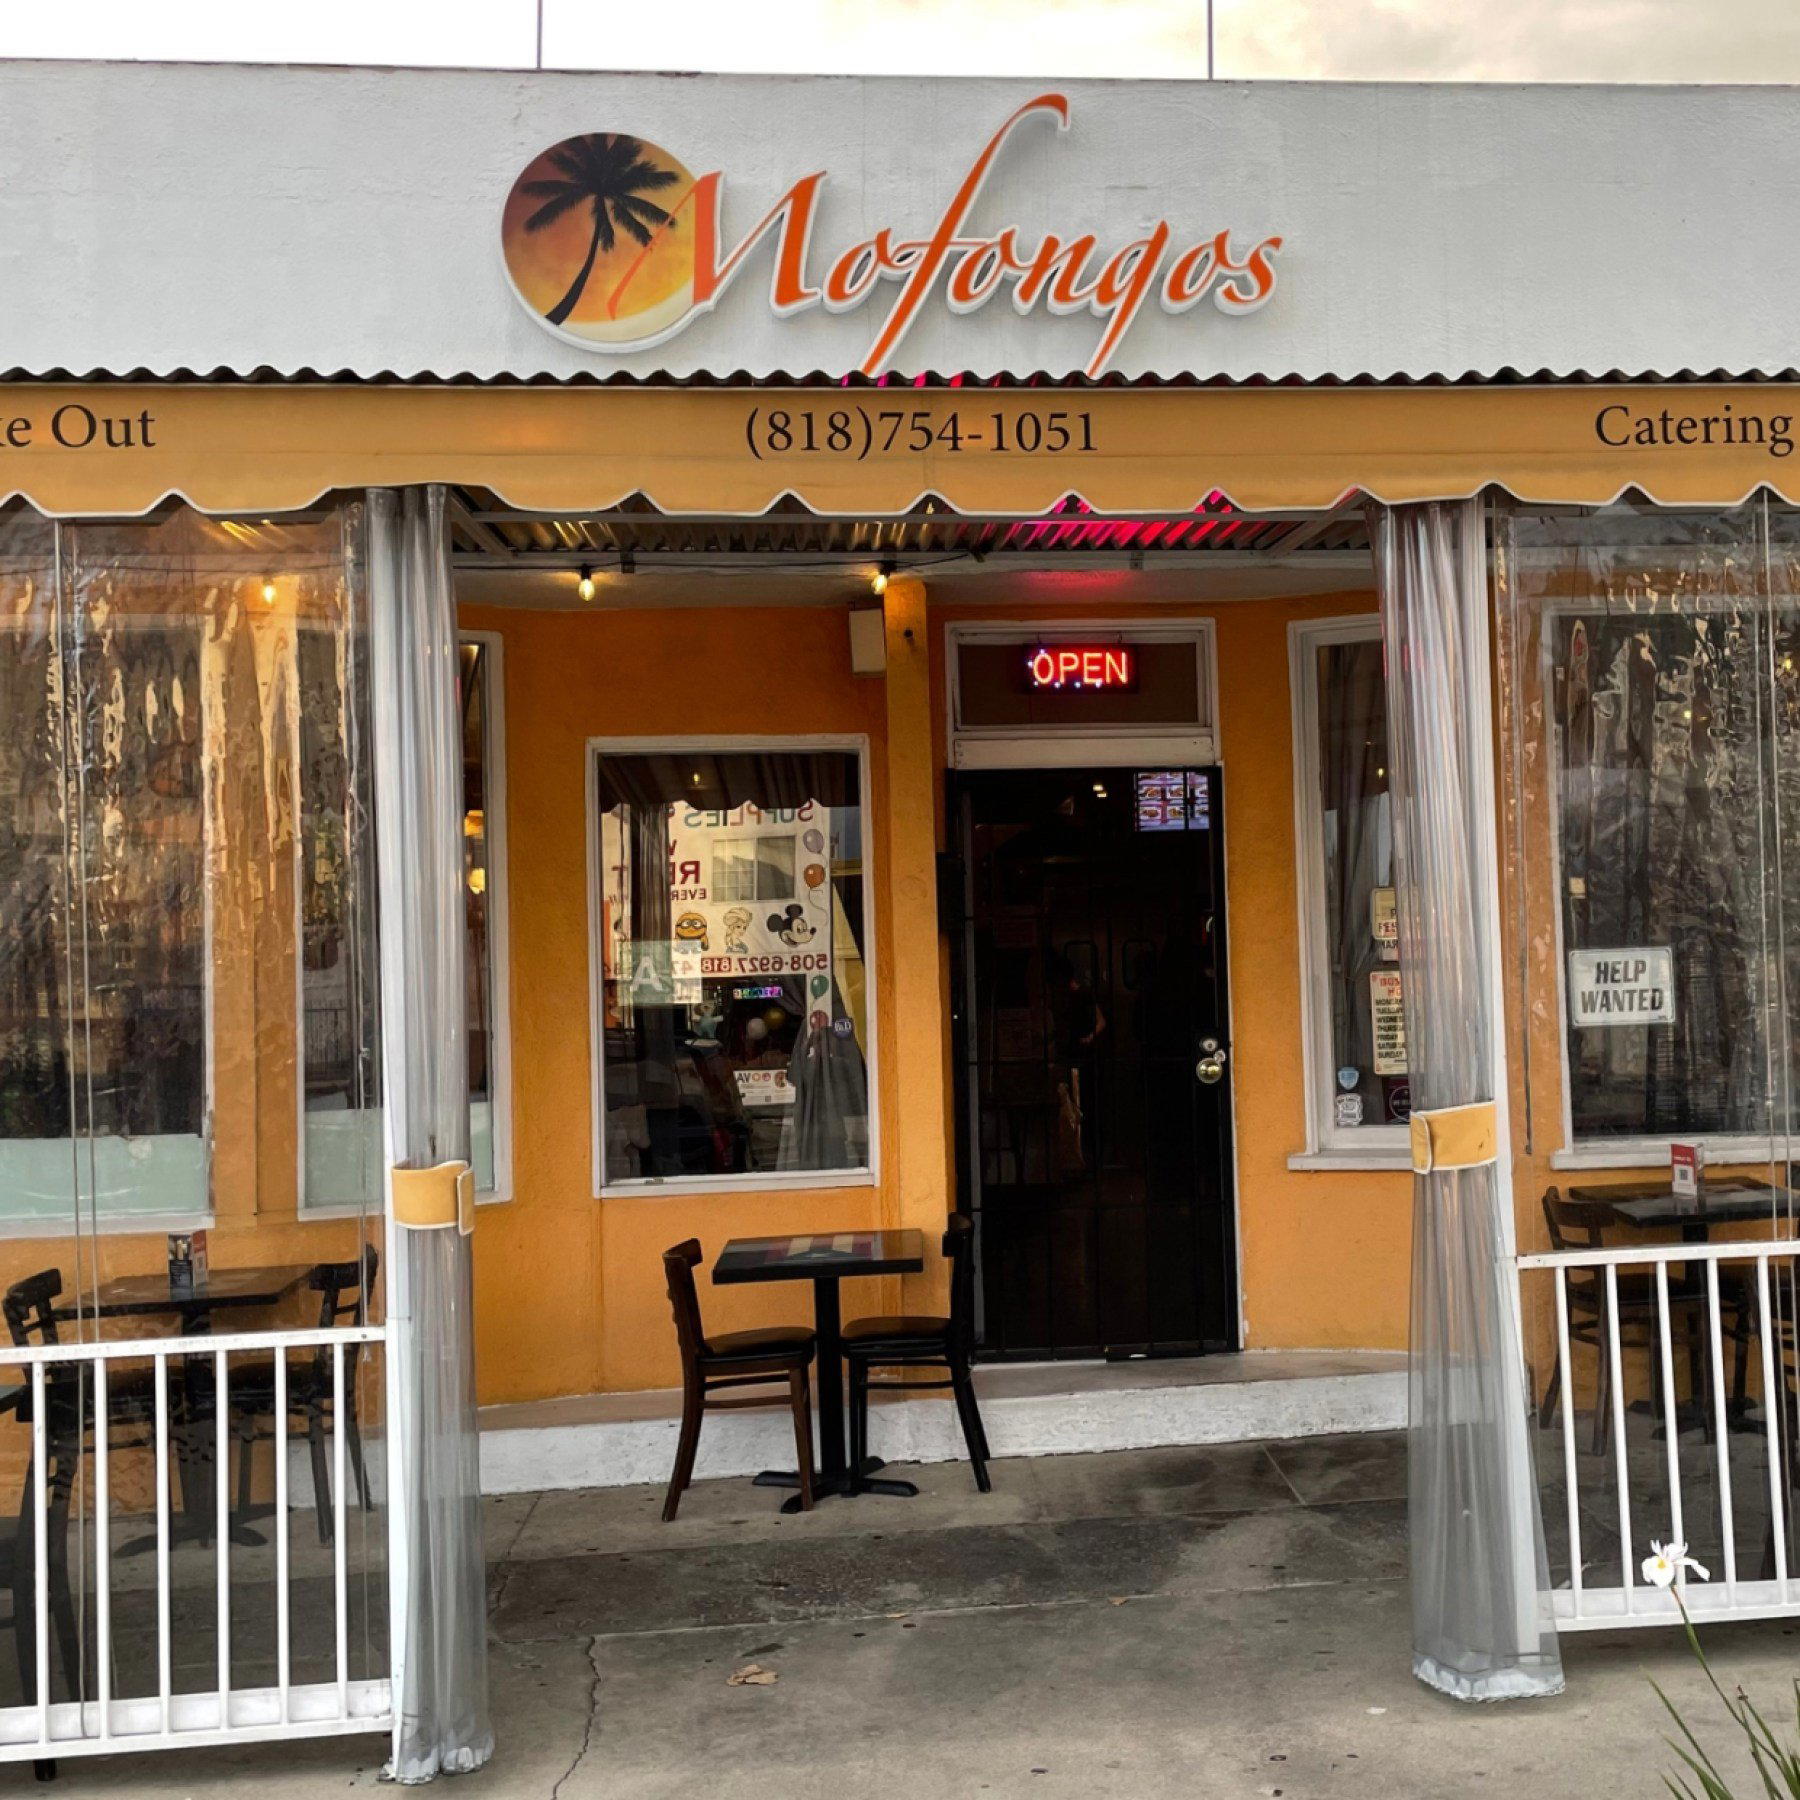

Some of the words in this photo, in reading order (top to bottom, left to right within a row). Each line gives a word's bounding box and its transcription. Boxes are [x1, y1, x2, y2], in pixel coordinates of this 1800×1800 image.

[608, 93, 1282, 378] Mofongos
[52, 404, 156, 448] Out
[745, 406, 1099, 461] (818)754-1051
[1595, 404, 1795, 458] Catering
[1032, 651, 1128, 685] OPEN
[1594, 960, 1647, 984] HELP
[1581, 988, 1664, 1014] WANTED
